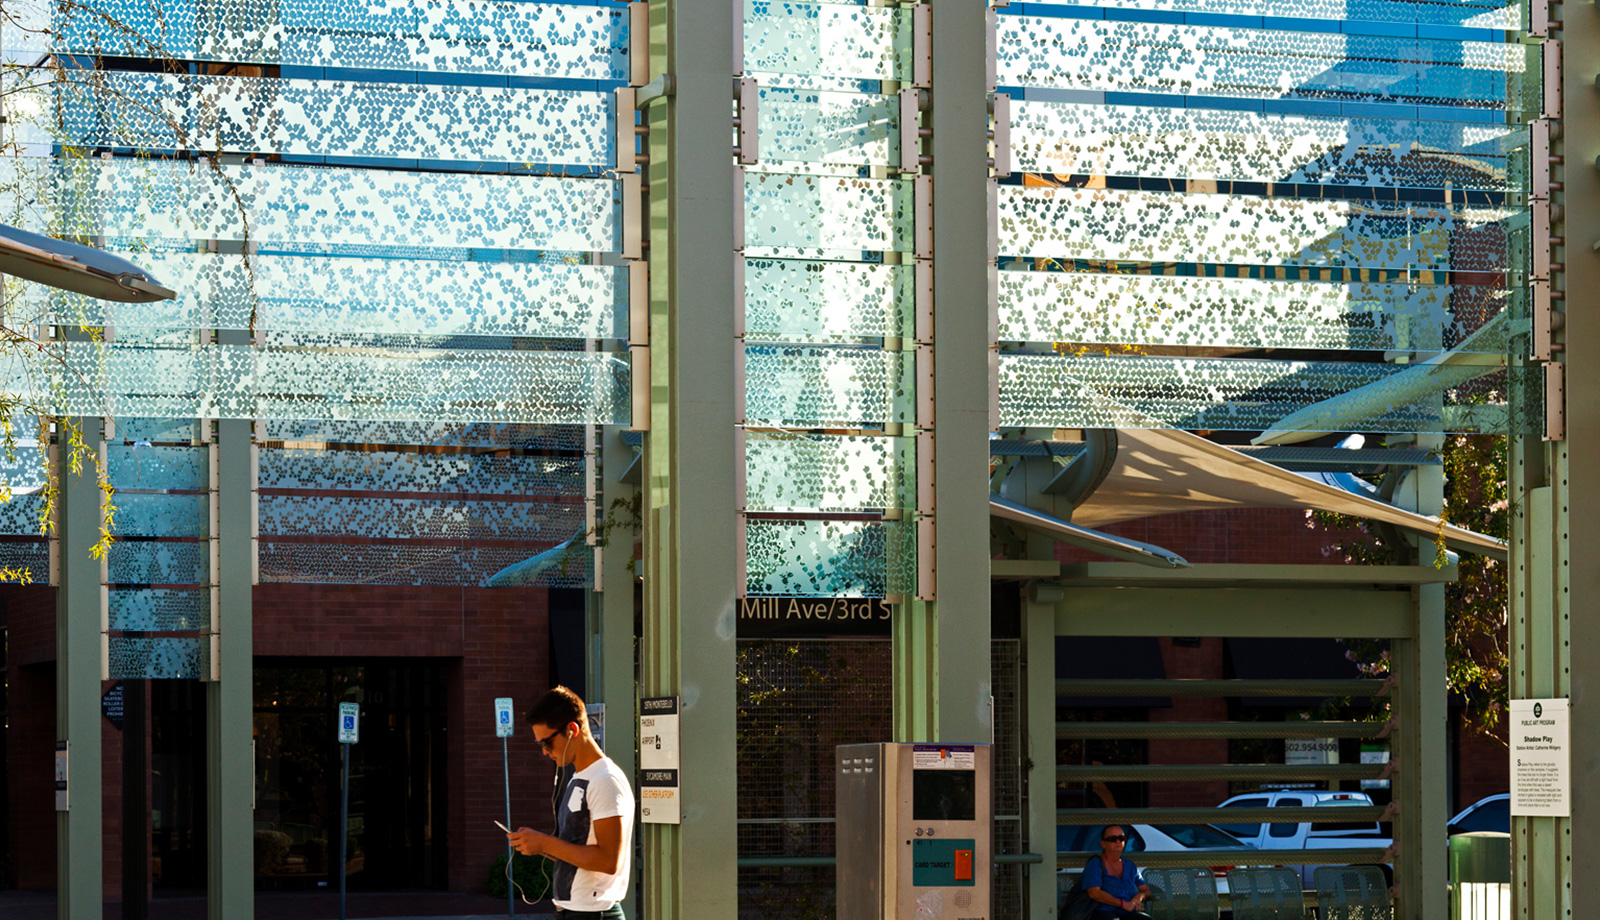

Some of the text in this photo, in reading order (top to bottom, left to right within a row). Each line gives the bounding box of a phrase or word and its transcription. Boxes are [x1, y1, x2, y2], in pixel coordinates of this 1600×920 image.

[740, 598, 779, 619] Mill
[785, 598, 872, 620] Ave/3rd
[1524, 735, 1553, 743] Shadow Play
